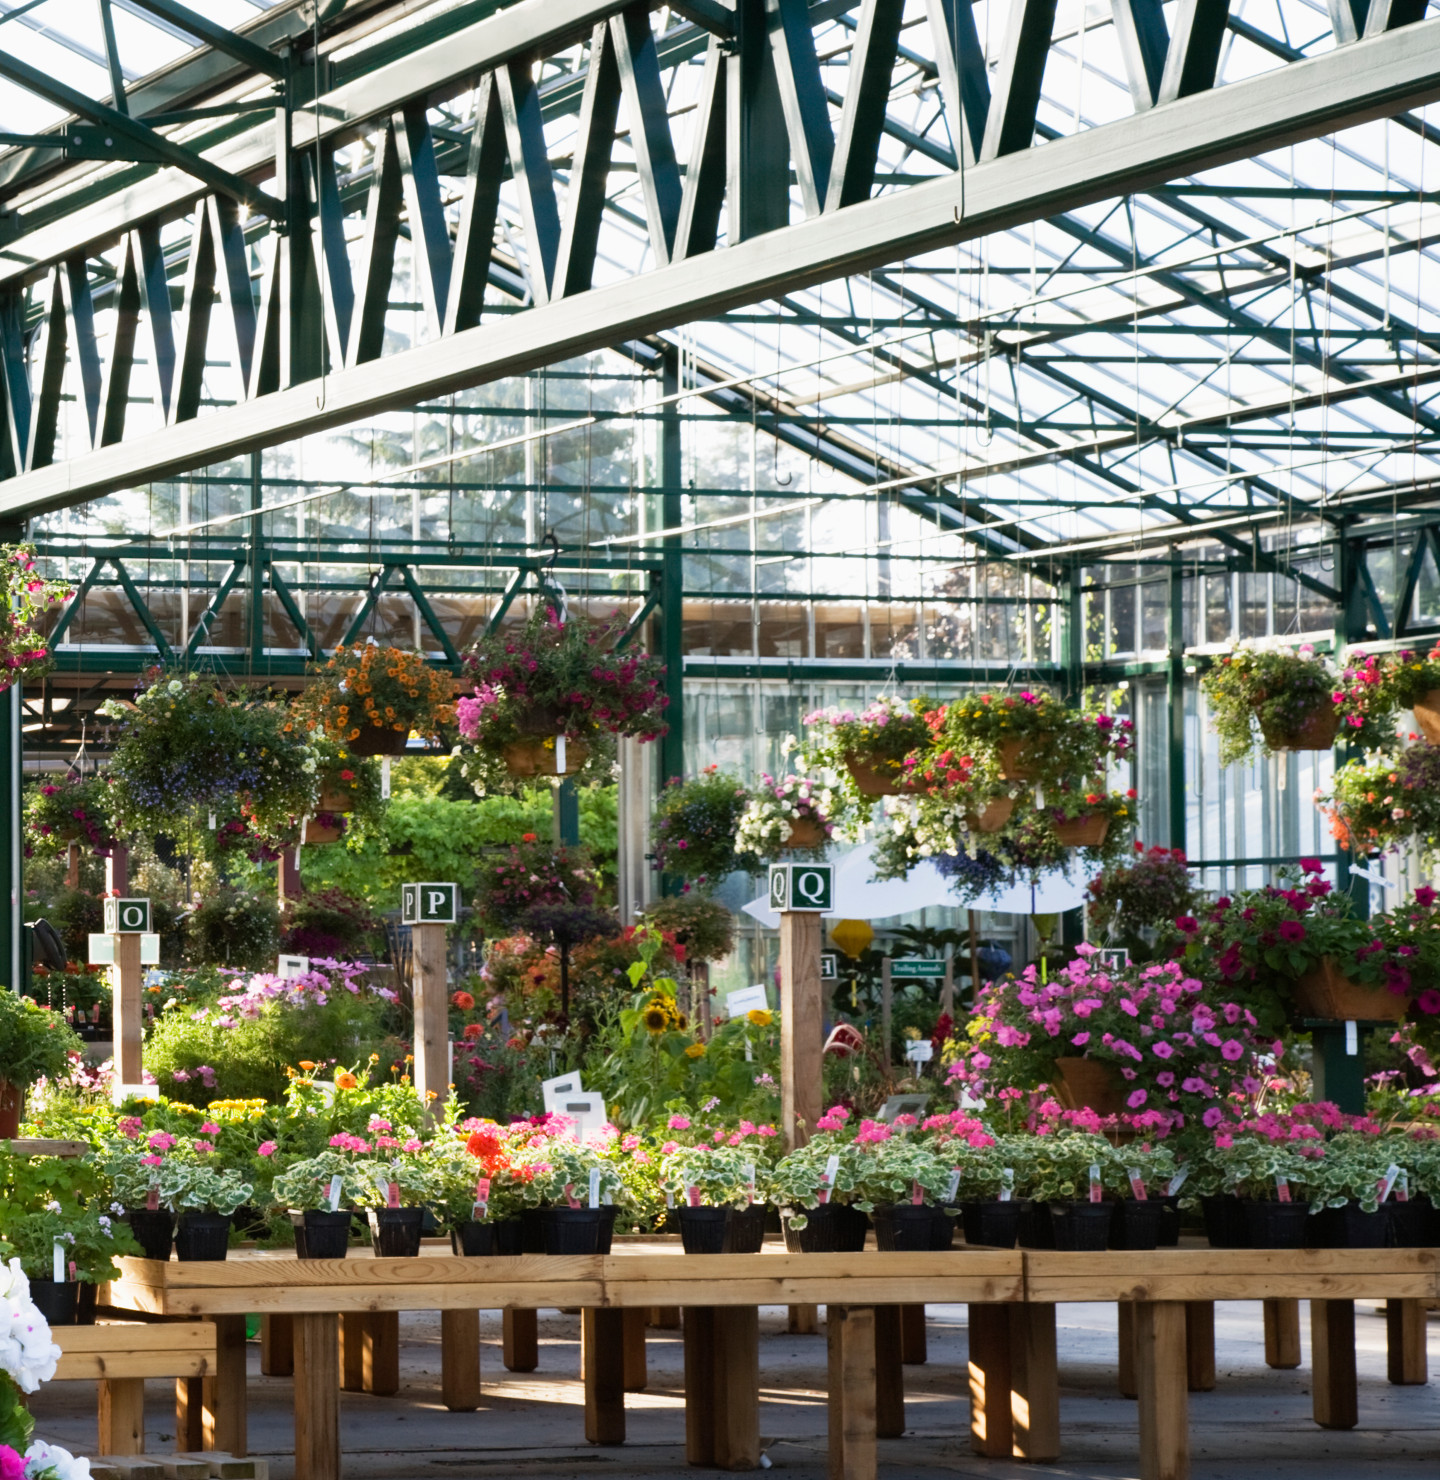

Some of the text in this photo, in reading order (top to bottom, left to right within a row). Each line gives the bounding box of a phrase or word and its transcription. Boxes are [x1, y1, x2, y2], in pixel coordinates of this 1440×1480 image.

[773, 872, 785, 903] Q
[798, 872, 825, 904] Q
[406, 892, 413, 915] P
[427, 891, 446, 914] P
[123, 906, 143, 927] O
